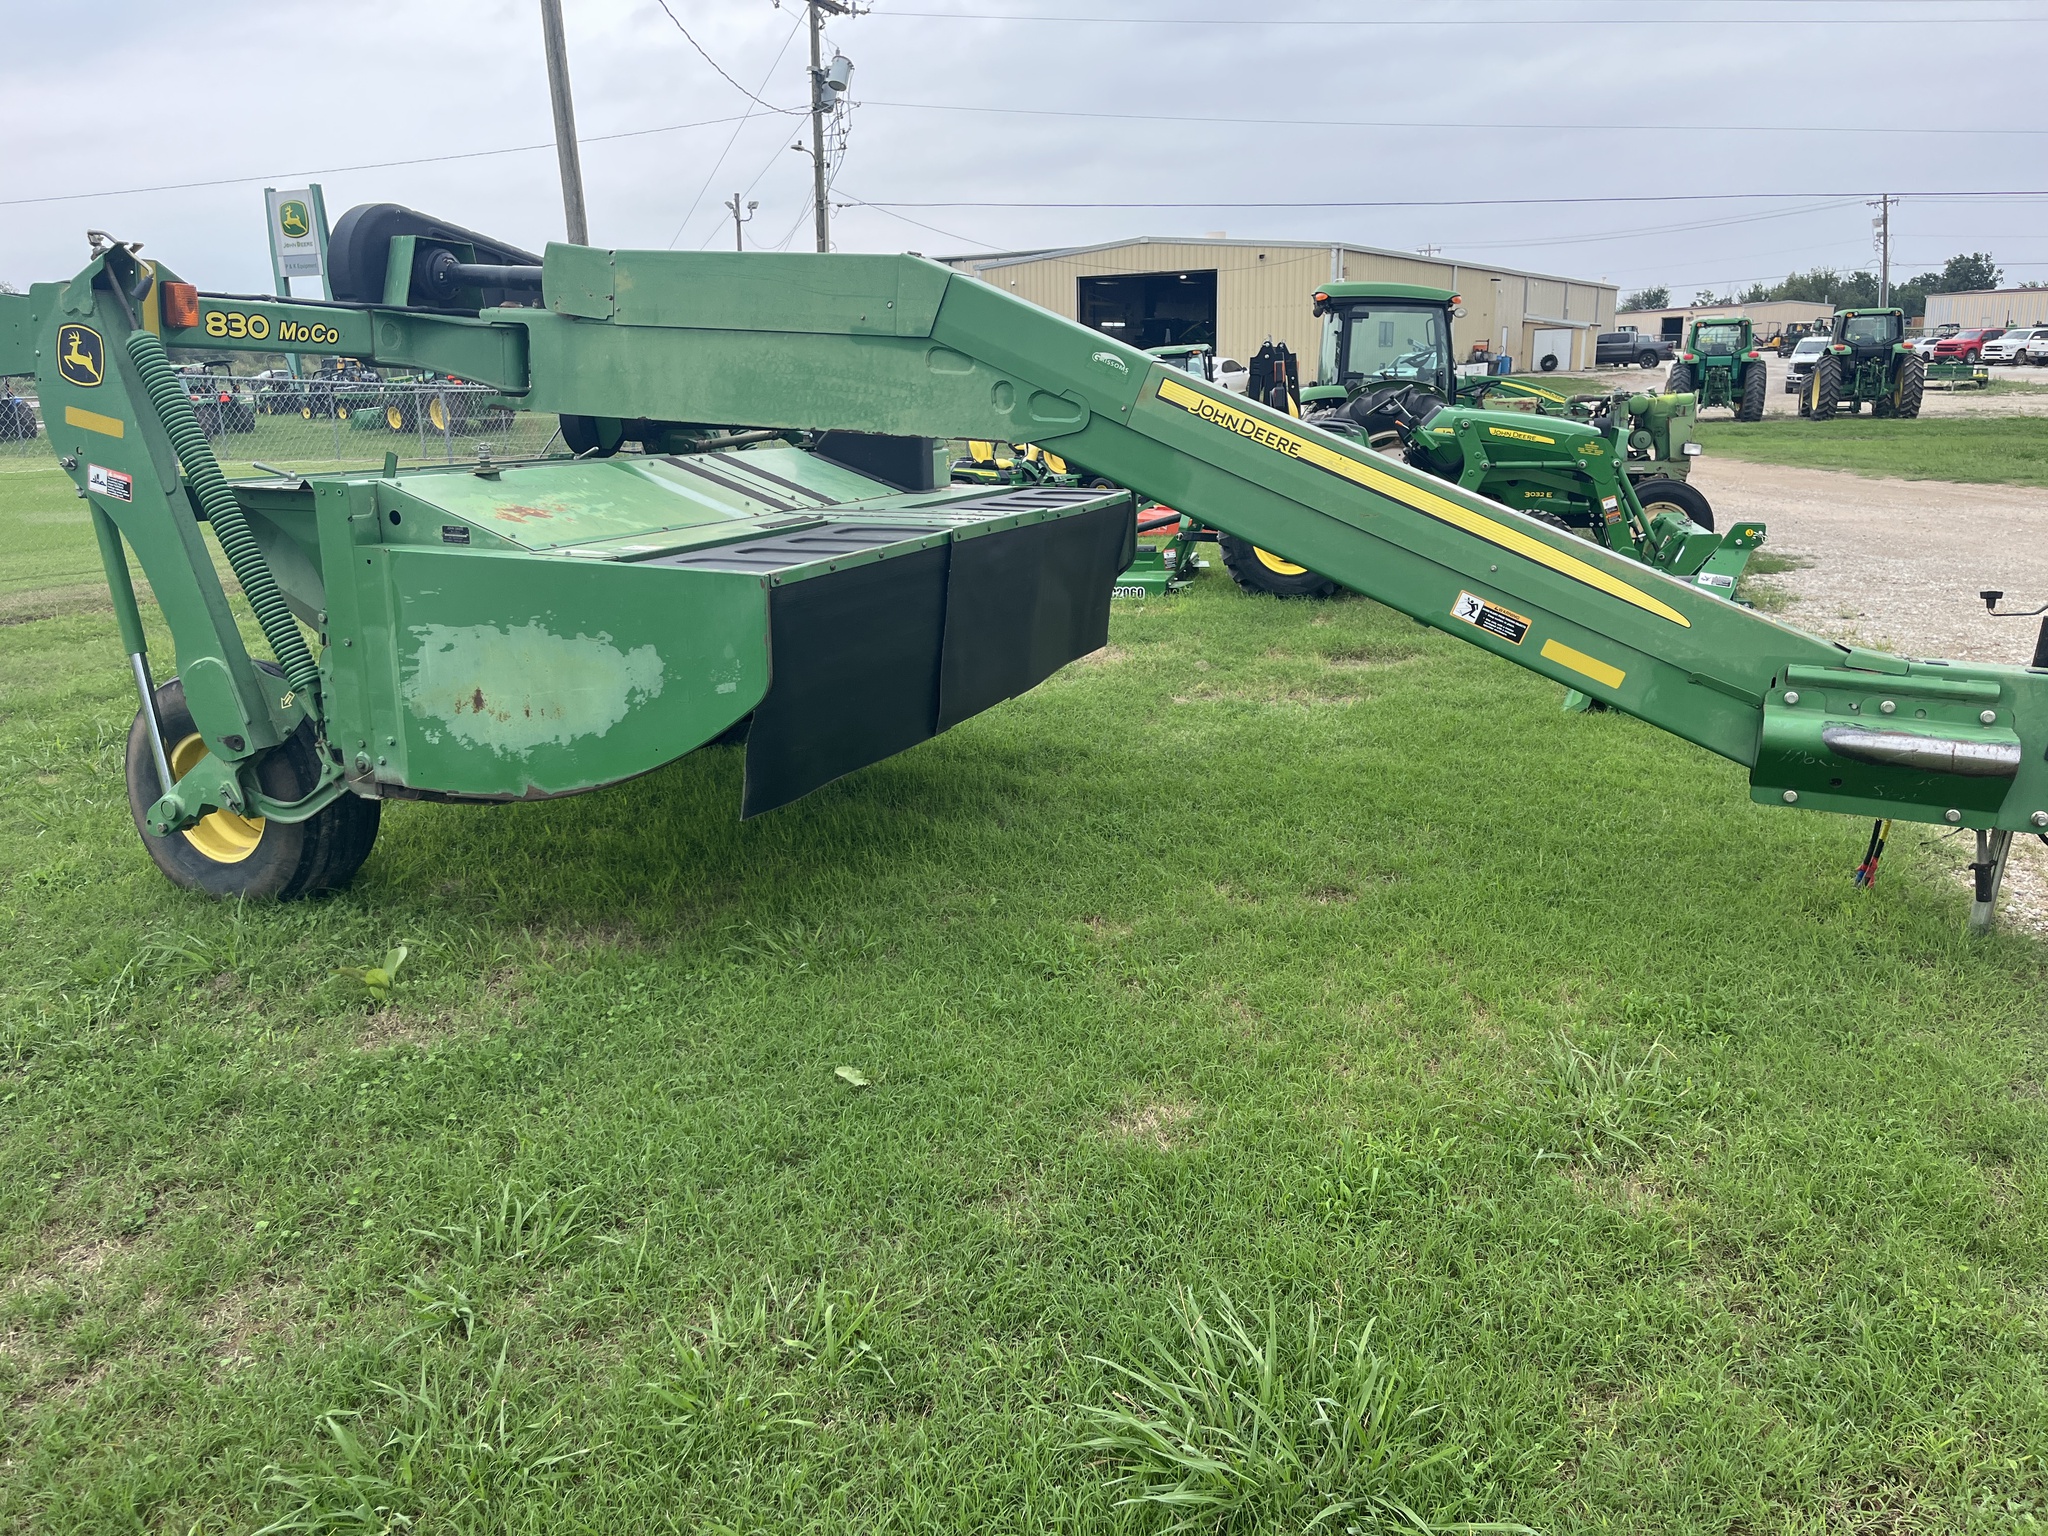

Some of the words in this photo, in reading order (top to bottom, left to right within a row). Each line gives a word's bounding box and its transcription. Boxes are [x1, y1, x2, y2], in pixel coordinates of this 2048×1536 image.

[205, 310, 270, 340] 830
[278, 320, 339, 344] MoCo
[1190, 399, 1239, 430] JOHN
[1240, 418, 1302, 456] DEERE
[1492, 429, 1512, 437] JOHN
[1512, 431, 1537, 440] DEERE
